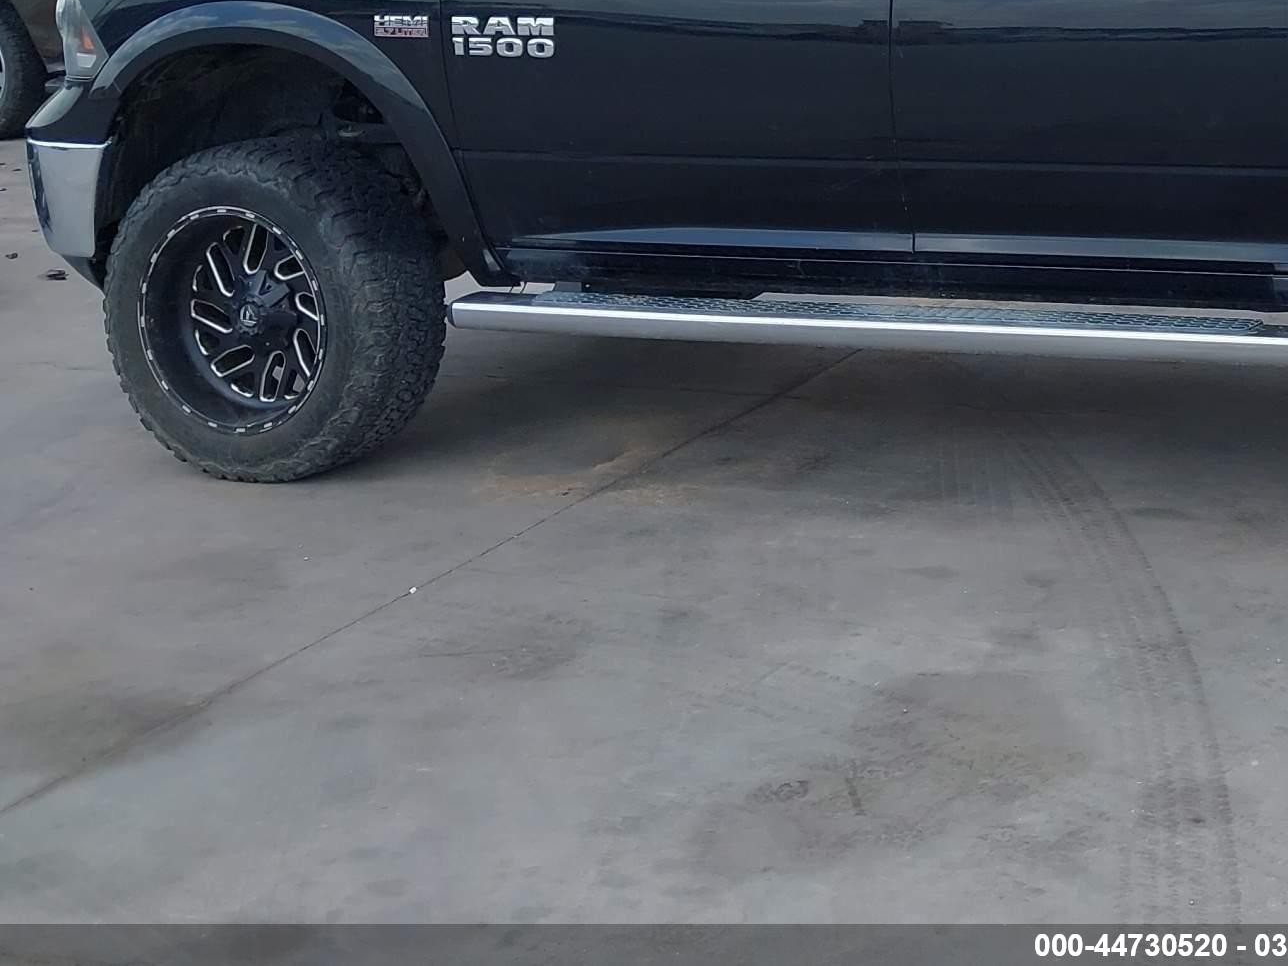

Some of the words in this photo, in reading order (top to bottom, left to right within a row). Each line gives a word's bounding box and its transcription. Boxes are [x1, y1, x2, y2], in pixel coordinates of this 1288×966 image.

[373, 15, 428, 26] HEMI
[451, 16, 555, 36] RAM
[452, 37, 555, 58] 1500
